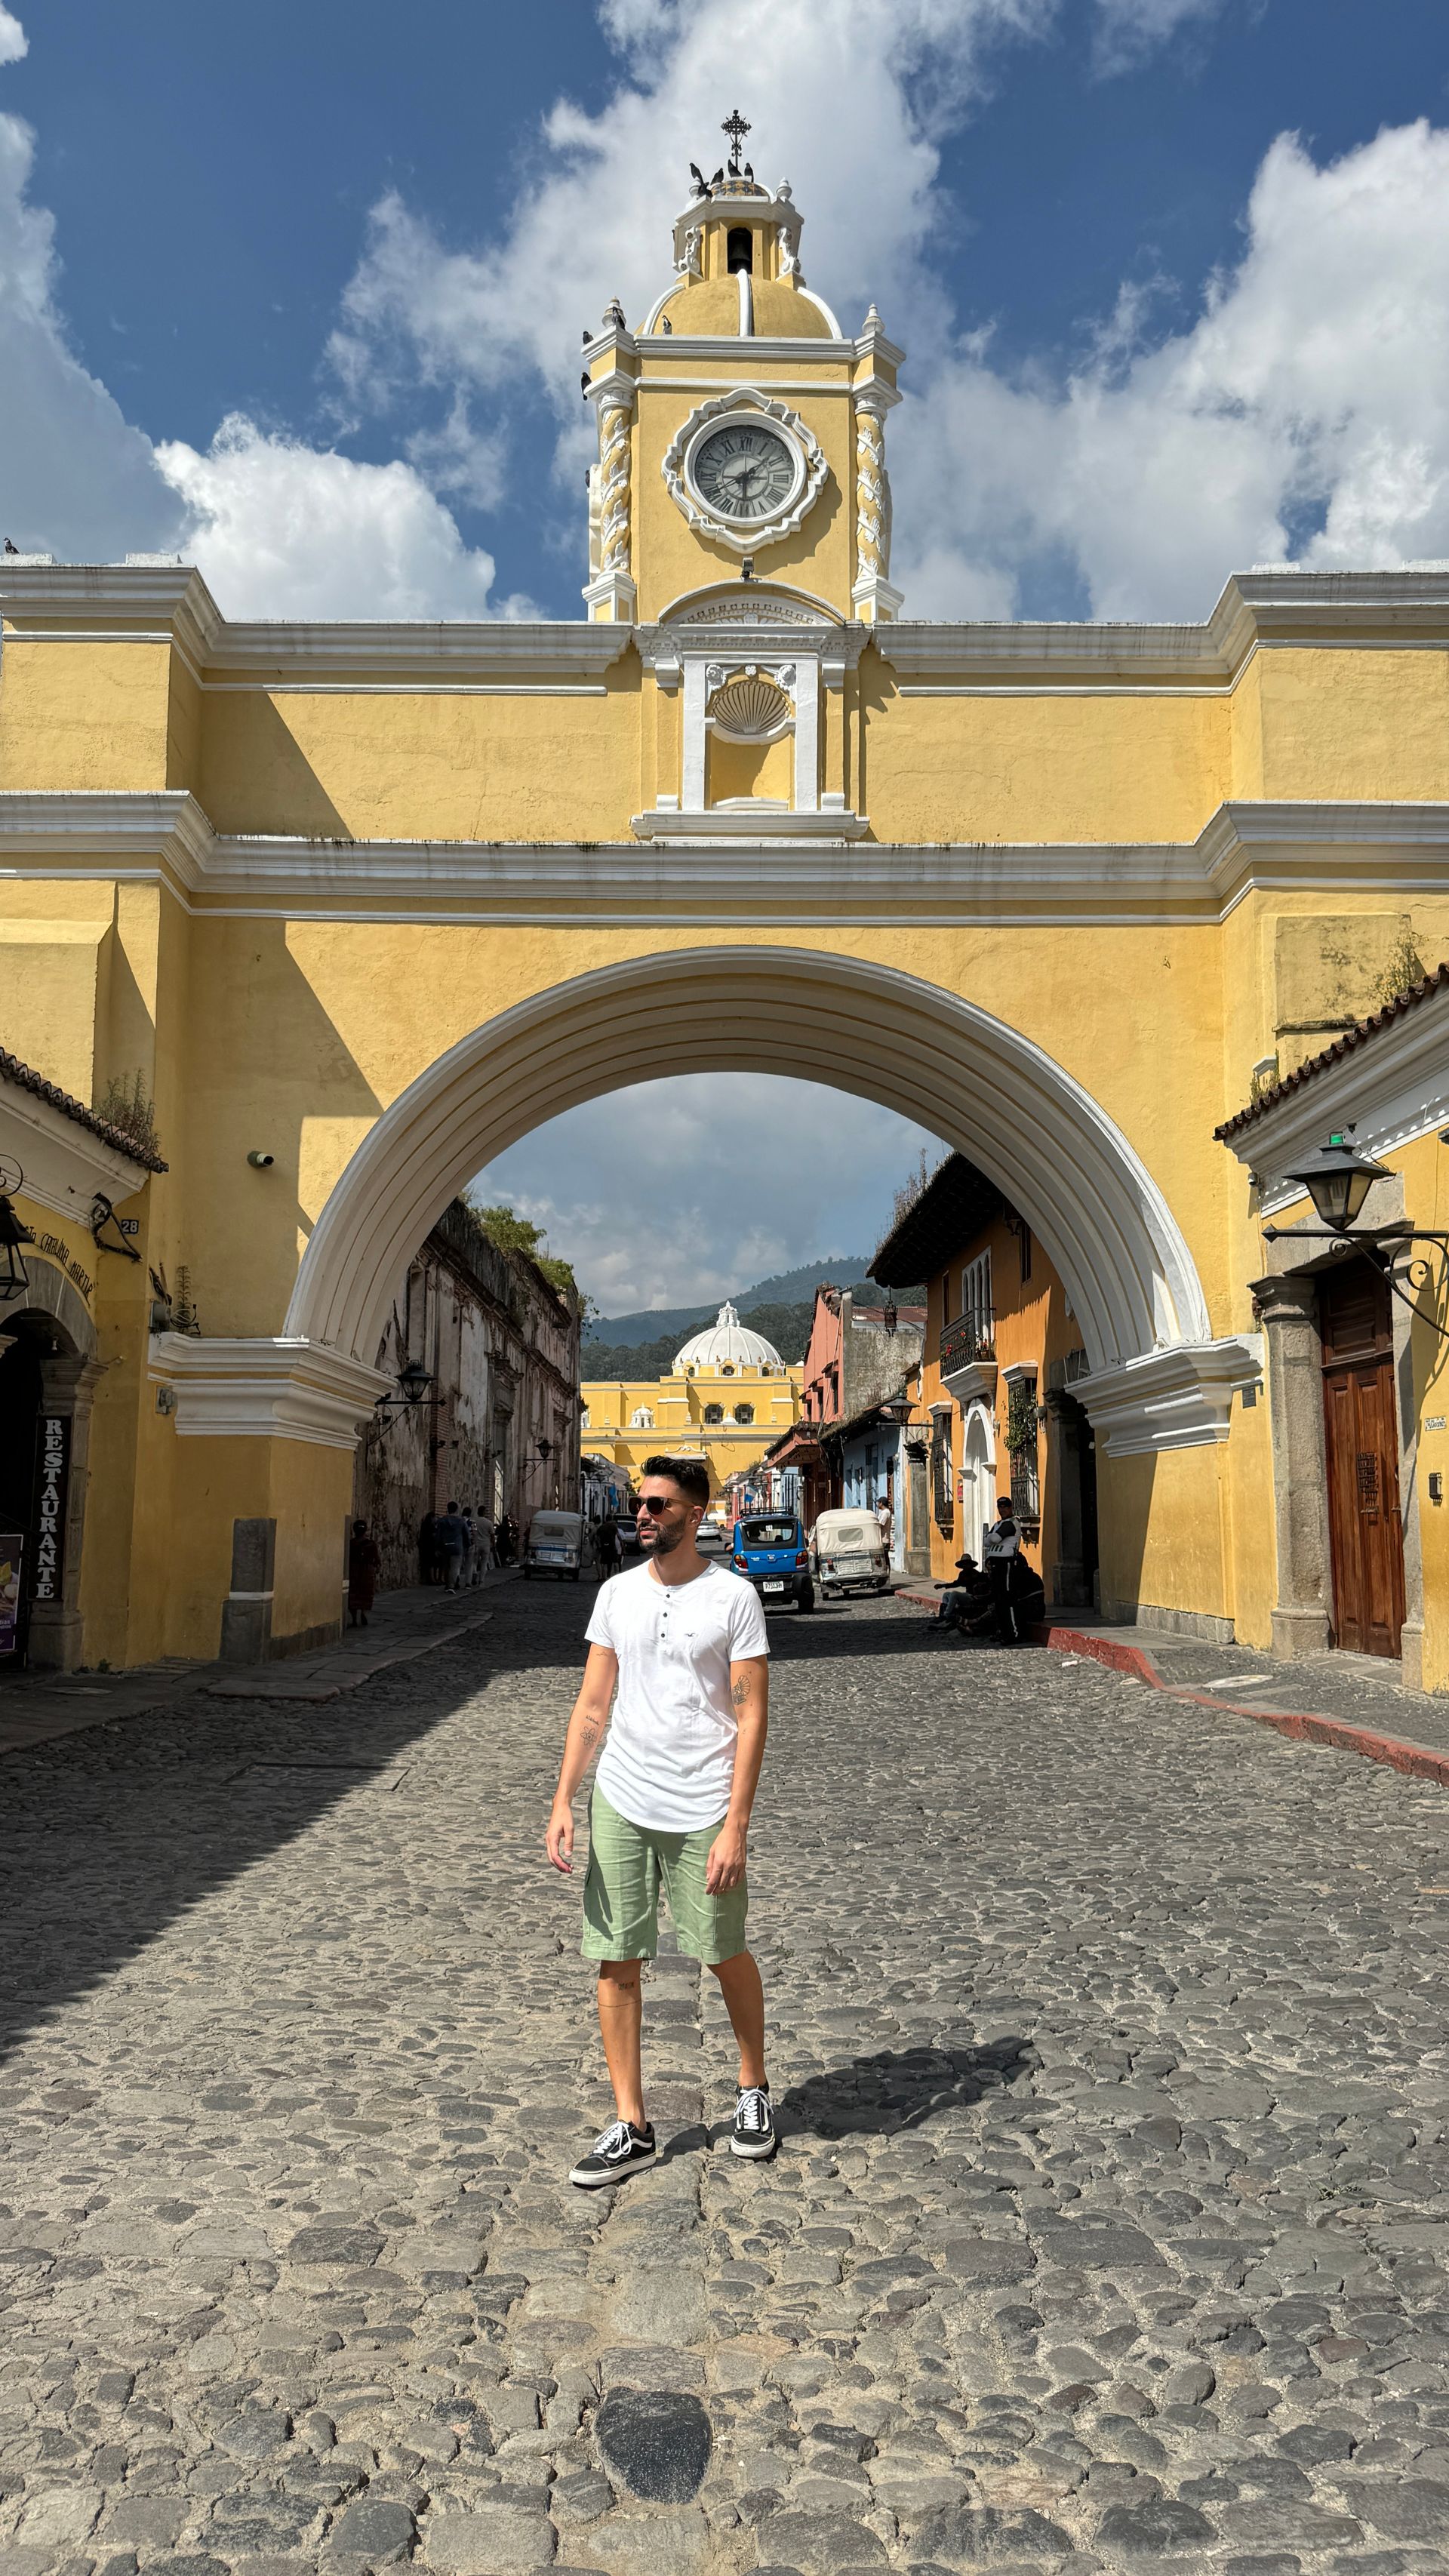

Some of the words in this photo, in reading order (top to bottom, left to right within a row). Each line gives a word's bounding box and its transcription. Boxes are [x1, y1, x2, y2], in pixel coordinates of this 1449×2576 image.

[122, 1220, 138, 1233] 28
[41, 1233, 70, 1264] CATALINA
[36, 1419, 63, 1599] RESTAURANTE
